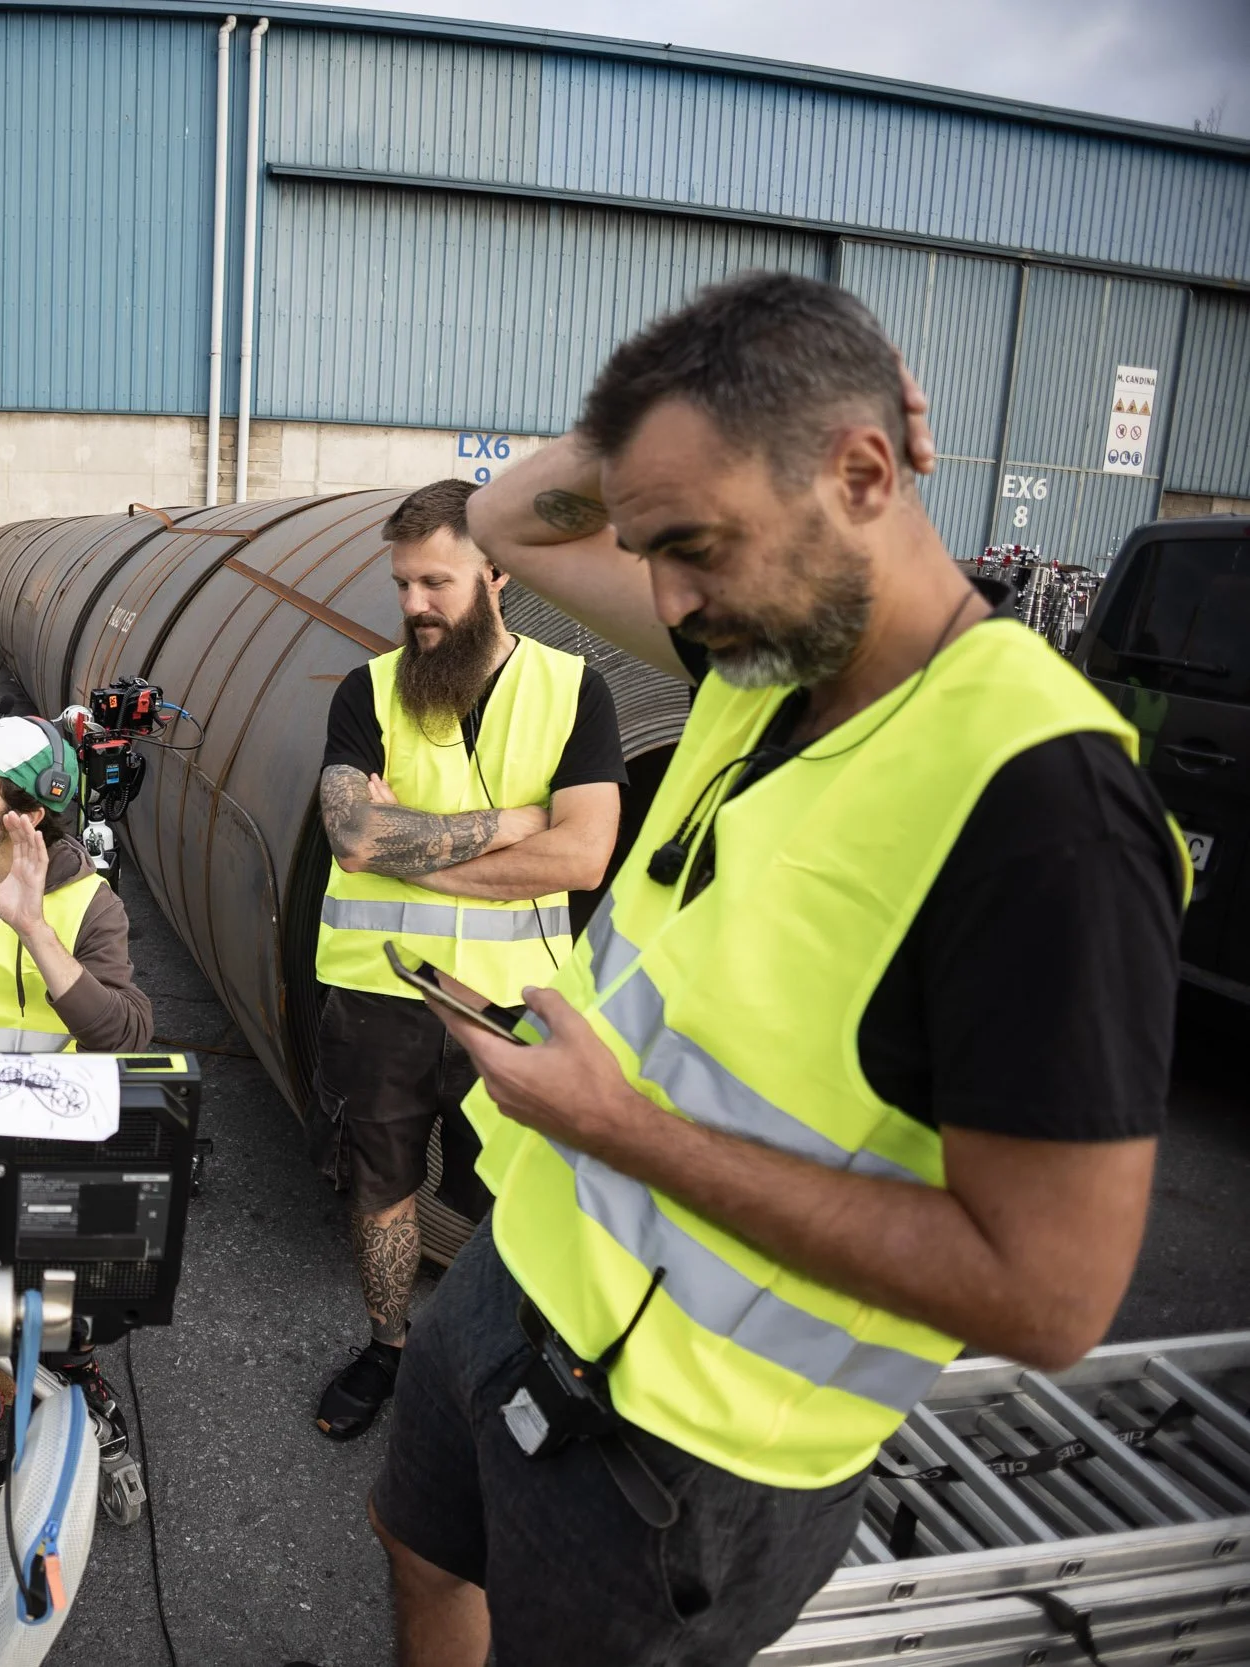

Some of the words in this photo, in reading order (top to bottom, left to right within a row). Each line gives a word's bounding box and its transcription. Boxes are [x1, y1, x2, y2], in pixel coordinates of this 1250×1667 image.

[1125, 375, 1155, 386] CANDINA
[475, 467, 490, 485] 9
[1002, 475, 1048, 501] EX6
[1013, 505, 1029, 528] 8
